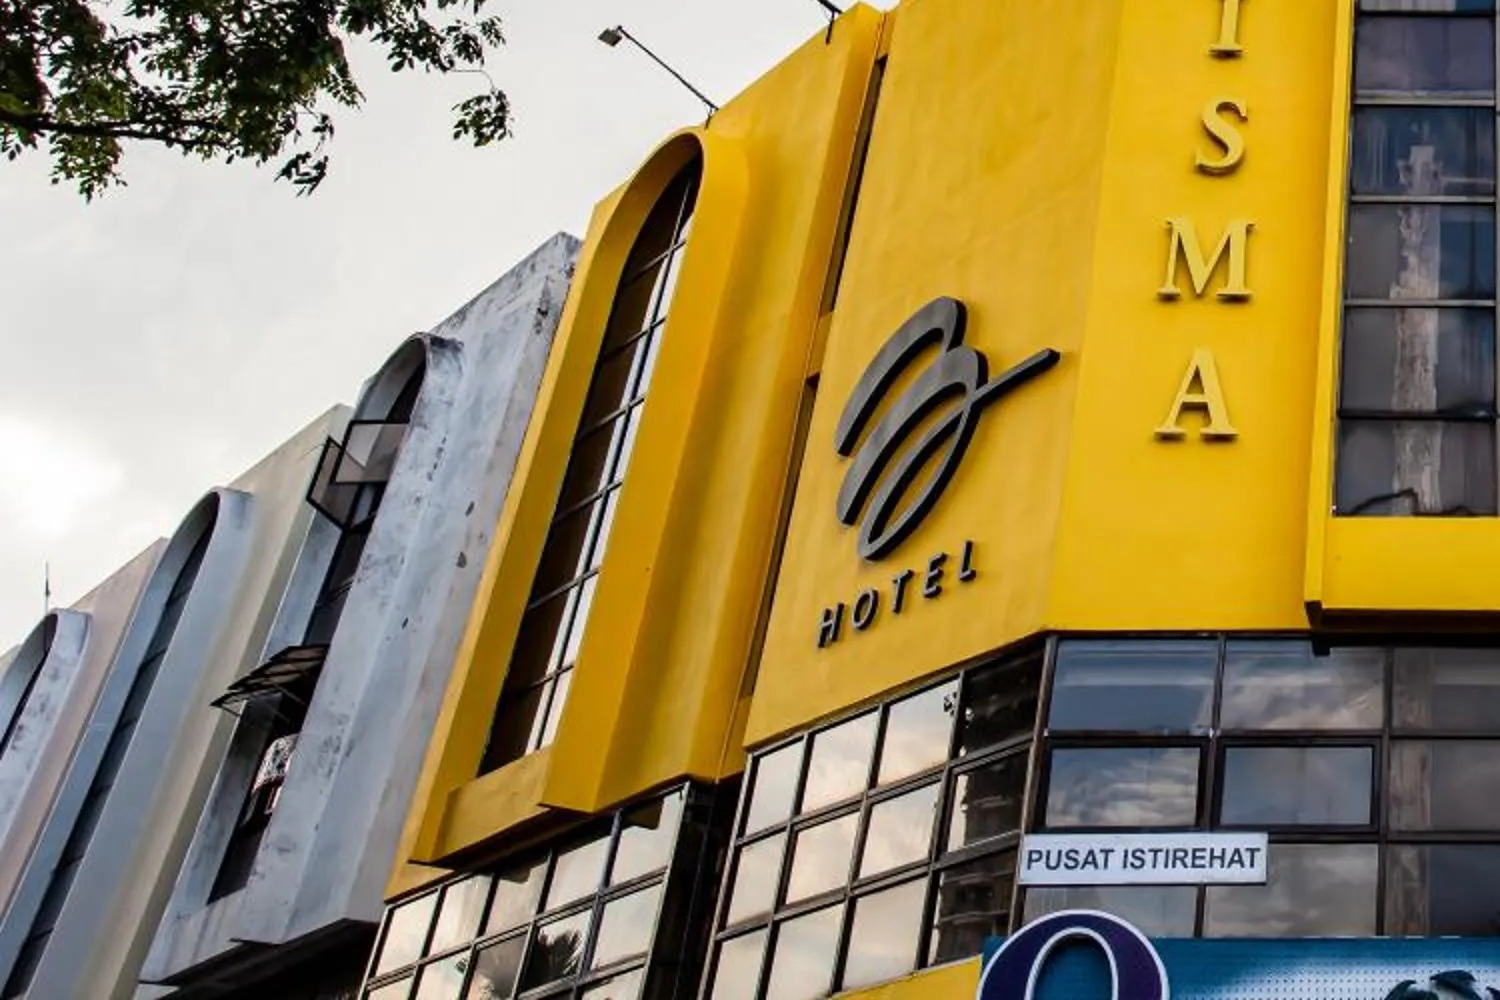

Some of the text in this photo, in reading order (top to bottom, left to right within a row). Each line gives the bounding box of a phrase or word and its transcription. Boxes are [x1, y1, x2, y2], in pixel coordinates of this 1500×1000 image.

[816, 540, 977, 649] HOTEL
[1026, 847, 1261, 871] PUSAT ISTIREHAT
